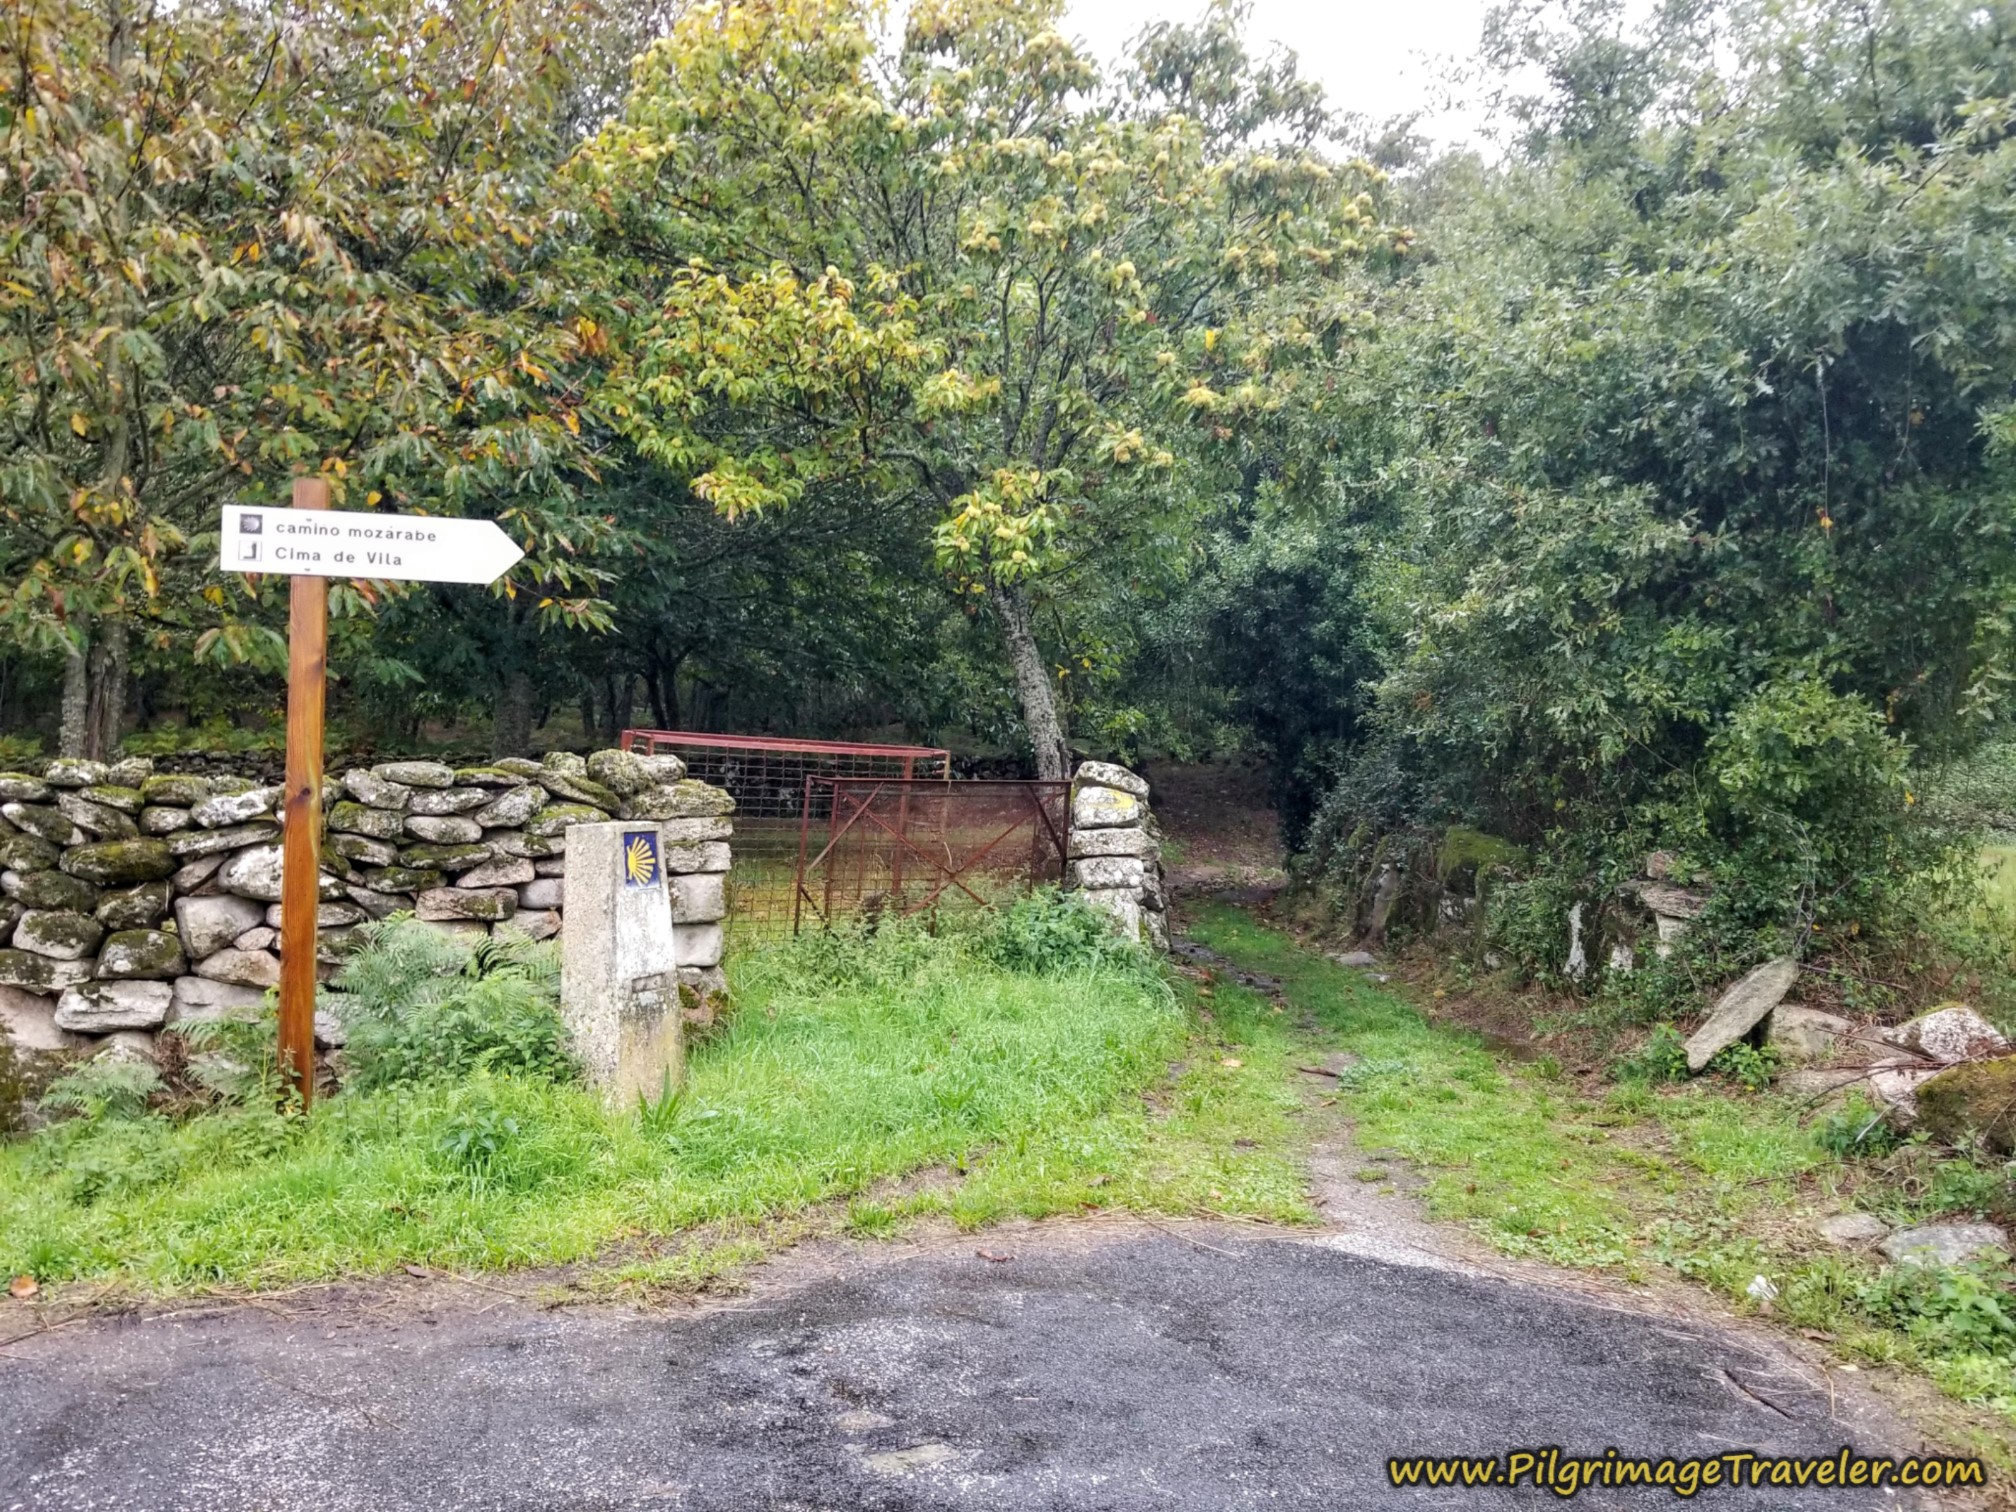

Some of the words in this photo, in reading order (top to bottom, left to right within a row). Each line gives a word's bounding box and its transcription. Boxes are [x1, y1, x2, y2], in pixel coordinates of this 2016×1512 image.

[276, 523, 340, 537] camino
[348, 526, 437, 542] mozárabe
[275, 546, 321, 562] Cima
[334, 551, 355, 564] de
[367, 551, 402, 566] Vila
